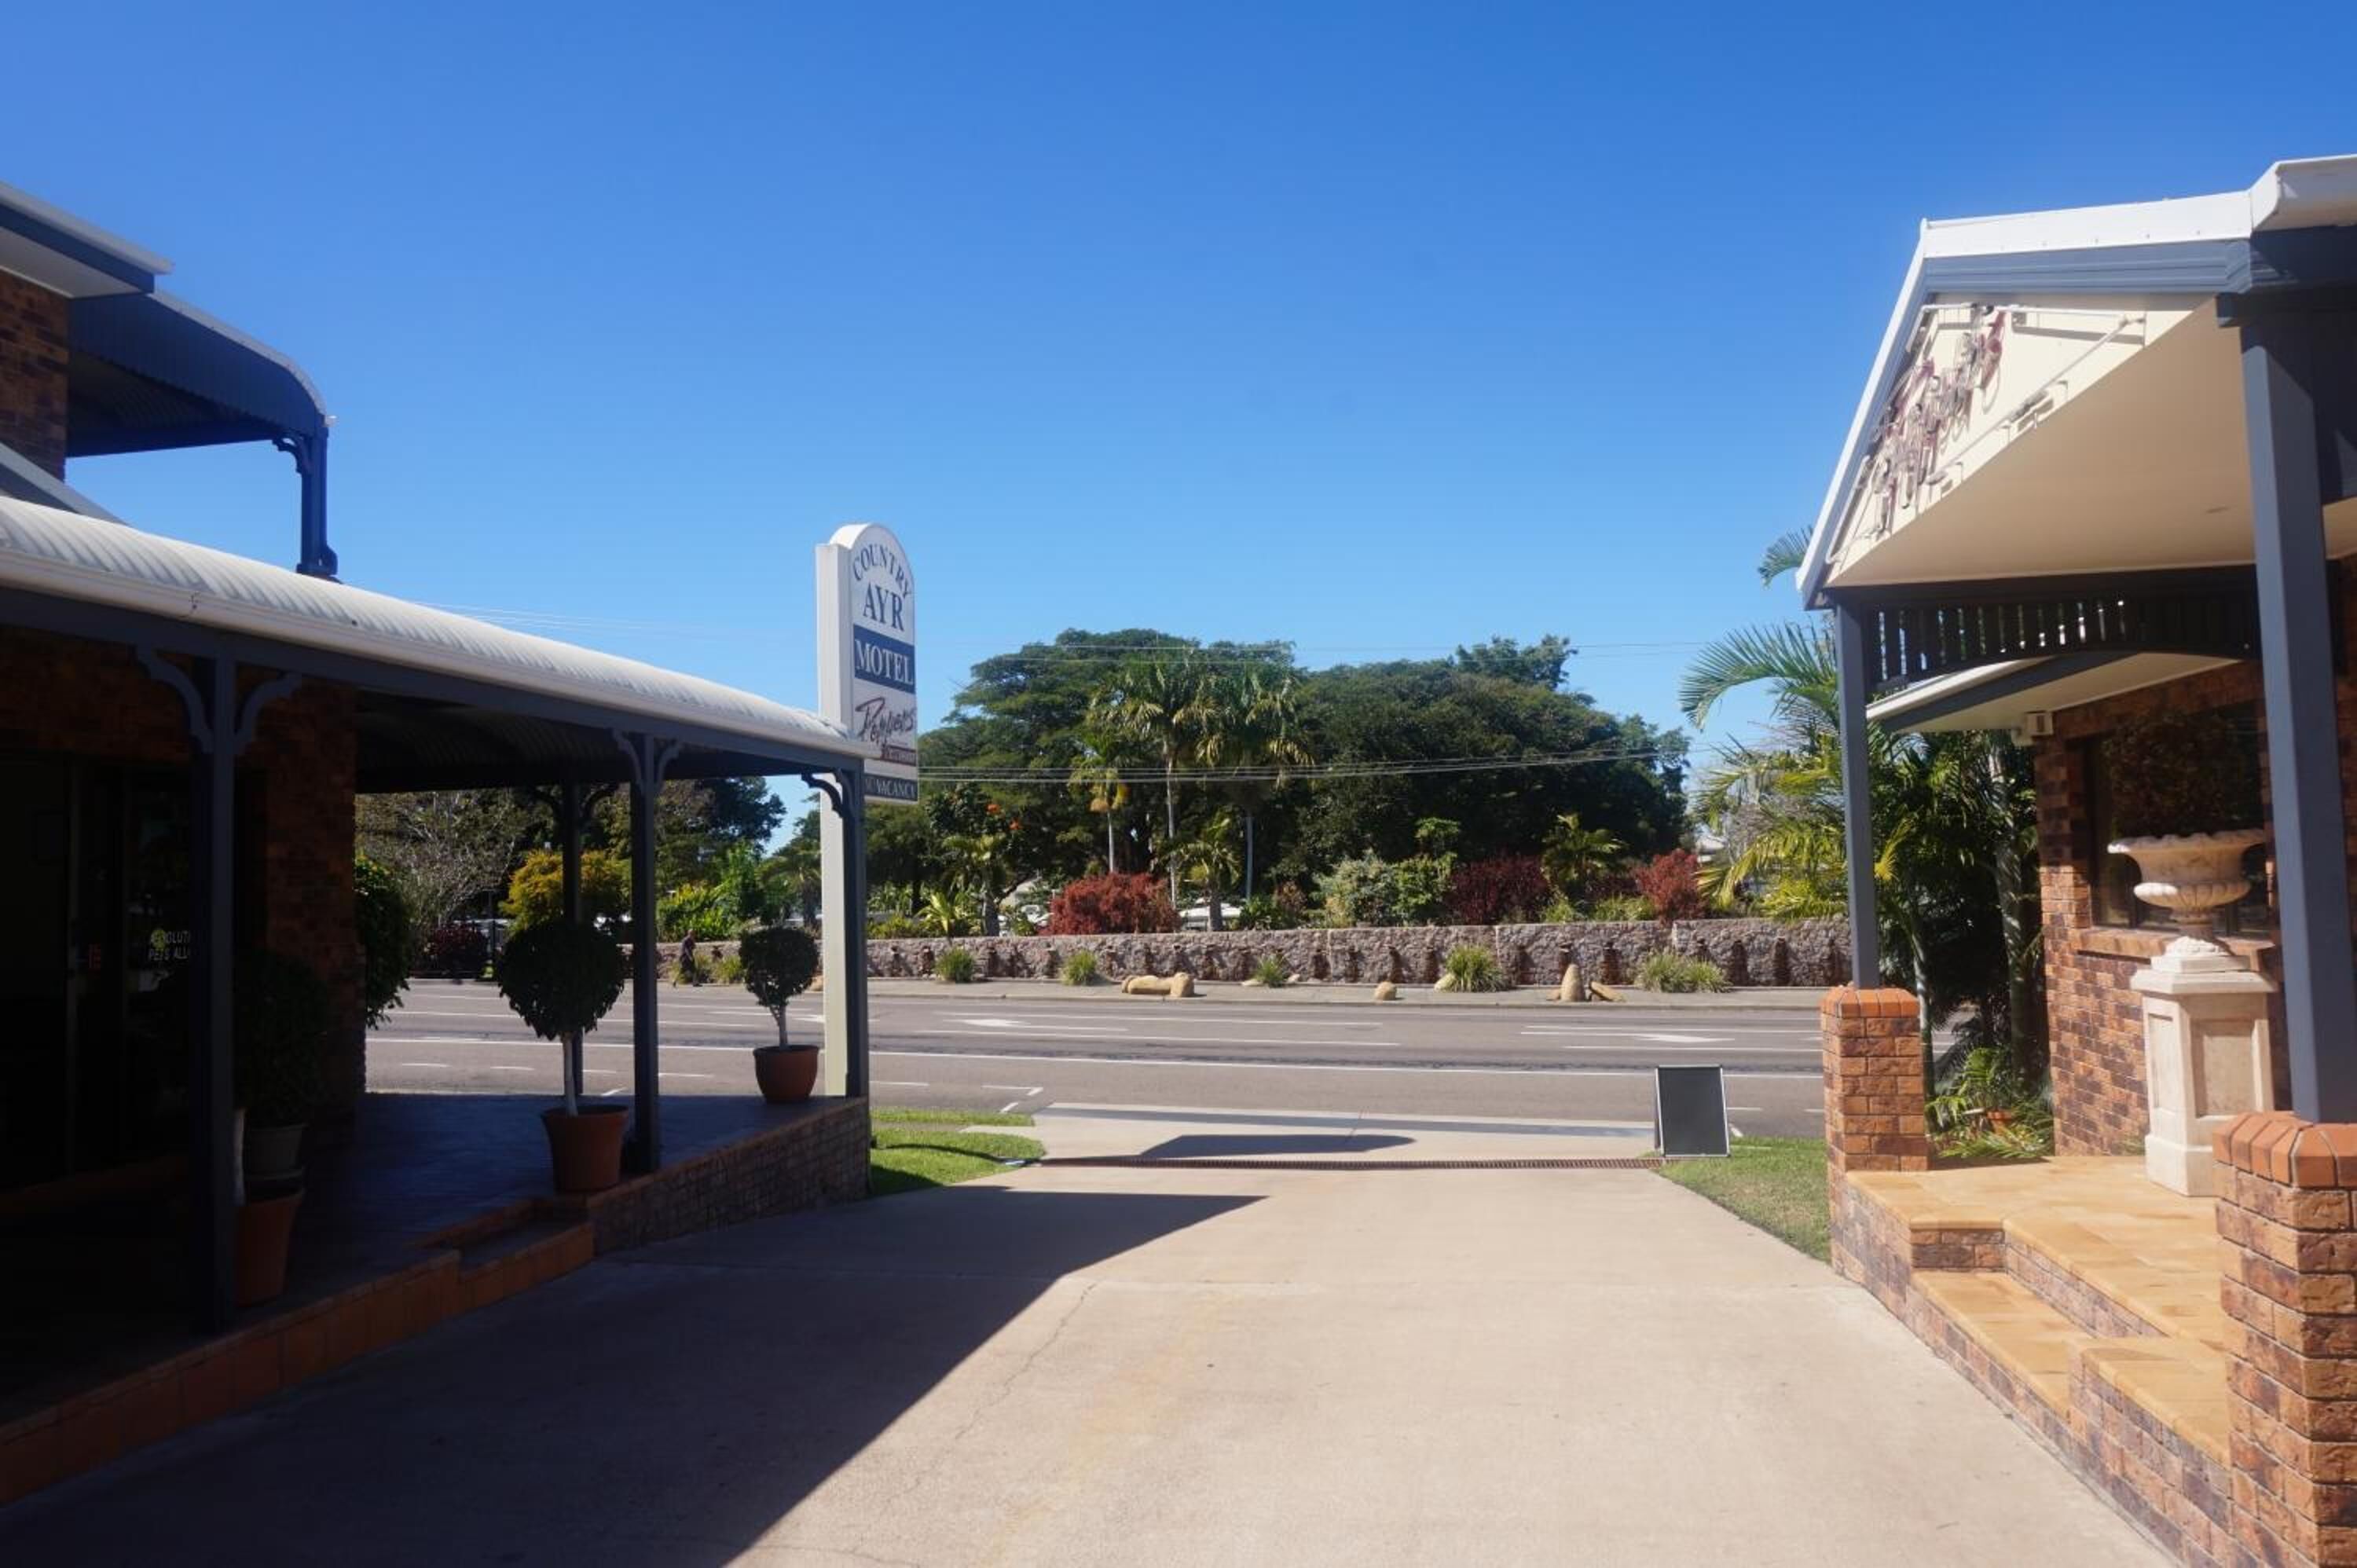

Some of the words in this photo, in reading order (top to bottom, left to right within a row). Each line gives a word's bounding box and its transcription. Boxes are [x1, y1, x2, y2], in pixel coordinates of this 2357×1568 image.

[852, 544, 912, 599] COUNTRY
[863, 581, 905, 632] AYR
[854, 639, 914, 686] MOTEL
[174, 947, 191, 961] ALL
